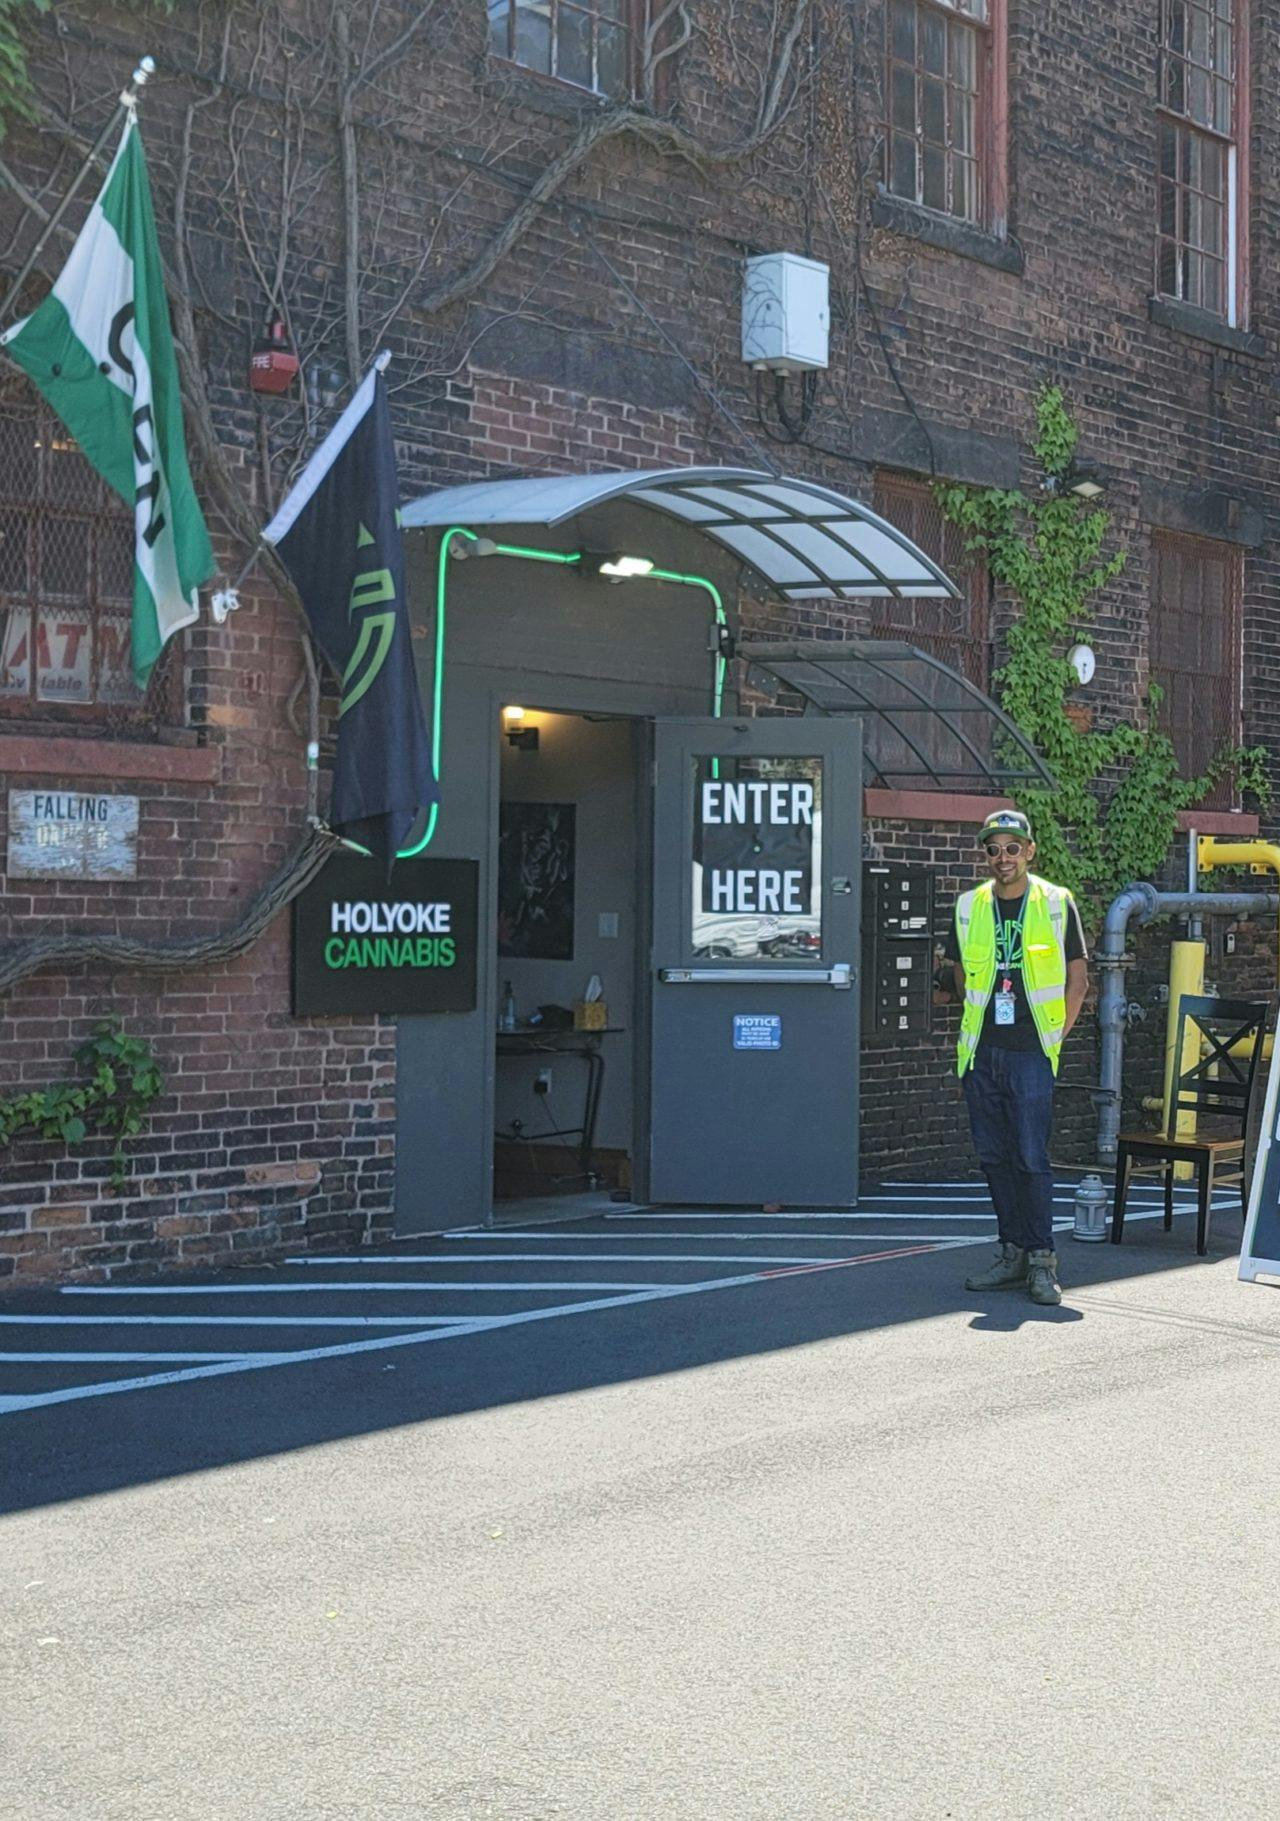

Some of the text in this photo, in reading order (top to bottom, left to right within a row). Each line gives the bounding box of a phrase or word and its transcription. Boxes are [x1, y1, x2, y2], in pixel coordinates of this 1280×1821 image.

[33, 794, 108, 821] FALLING
[702, 782, 814, 825] ENTER
[711, 869, 804, 912] HERE
[331, 901, 451, 933] HOLYOKE
[324, 937, 457, 969] CANNABIS
[735, 1018, 779, 1026] NOTICE
